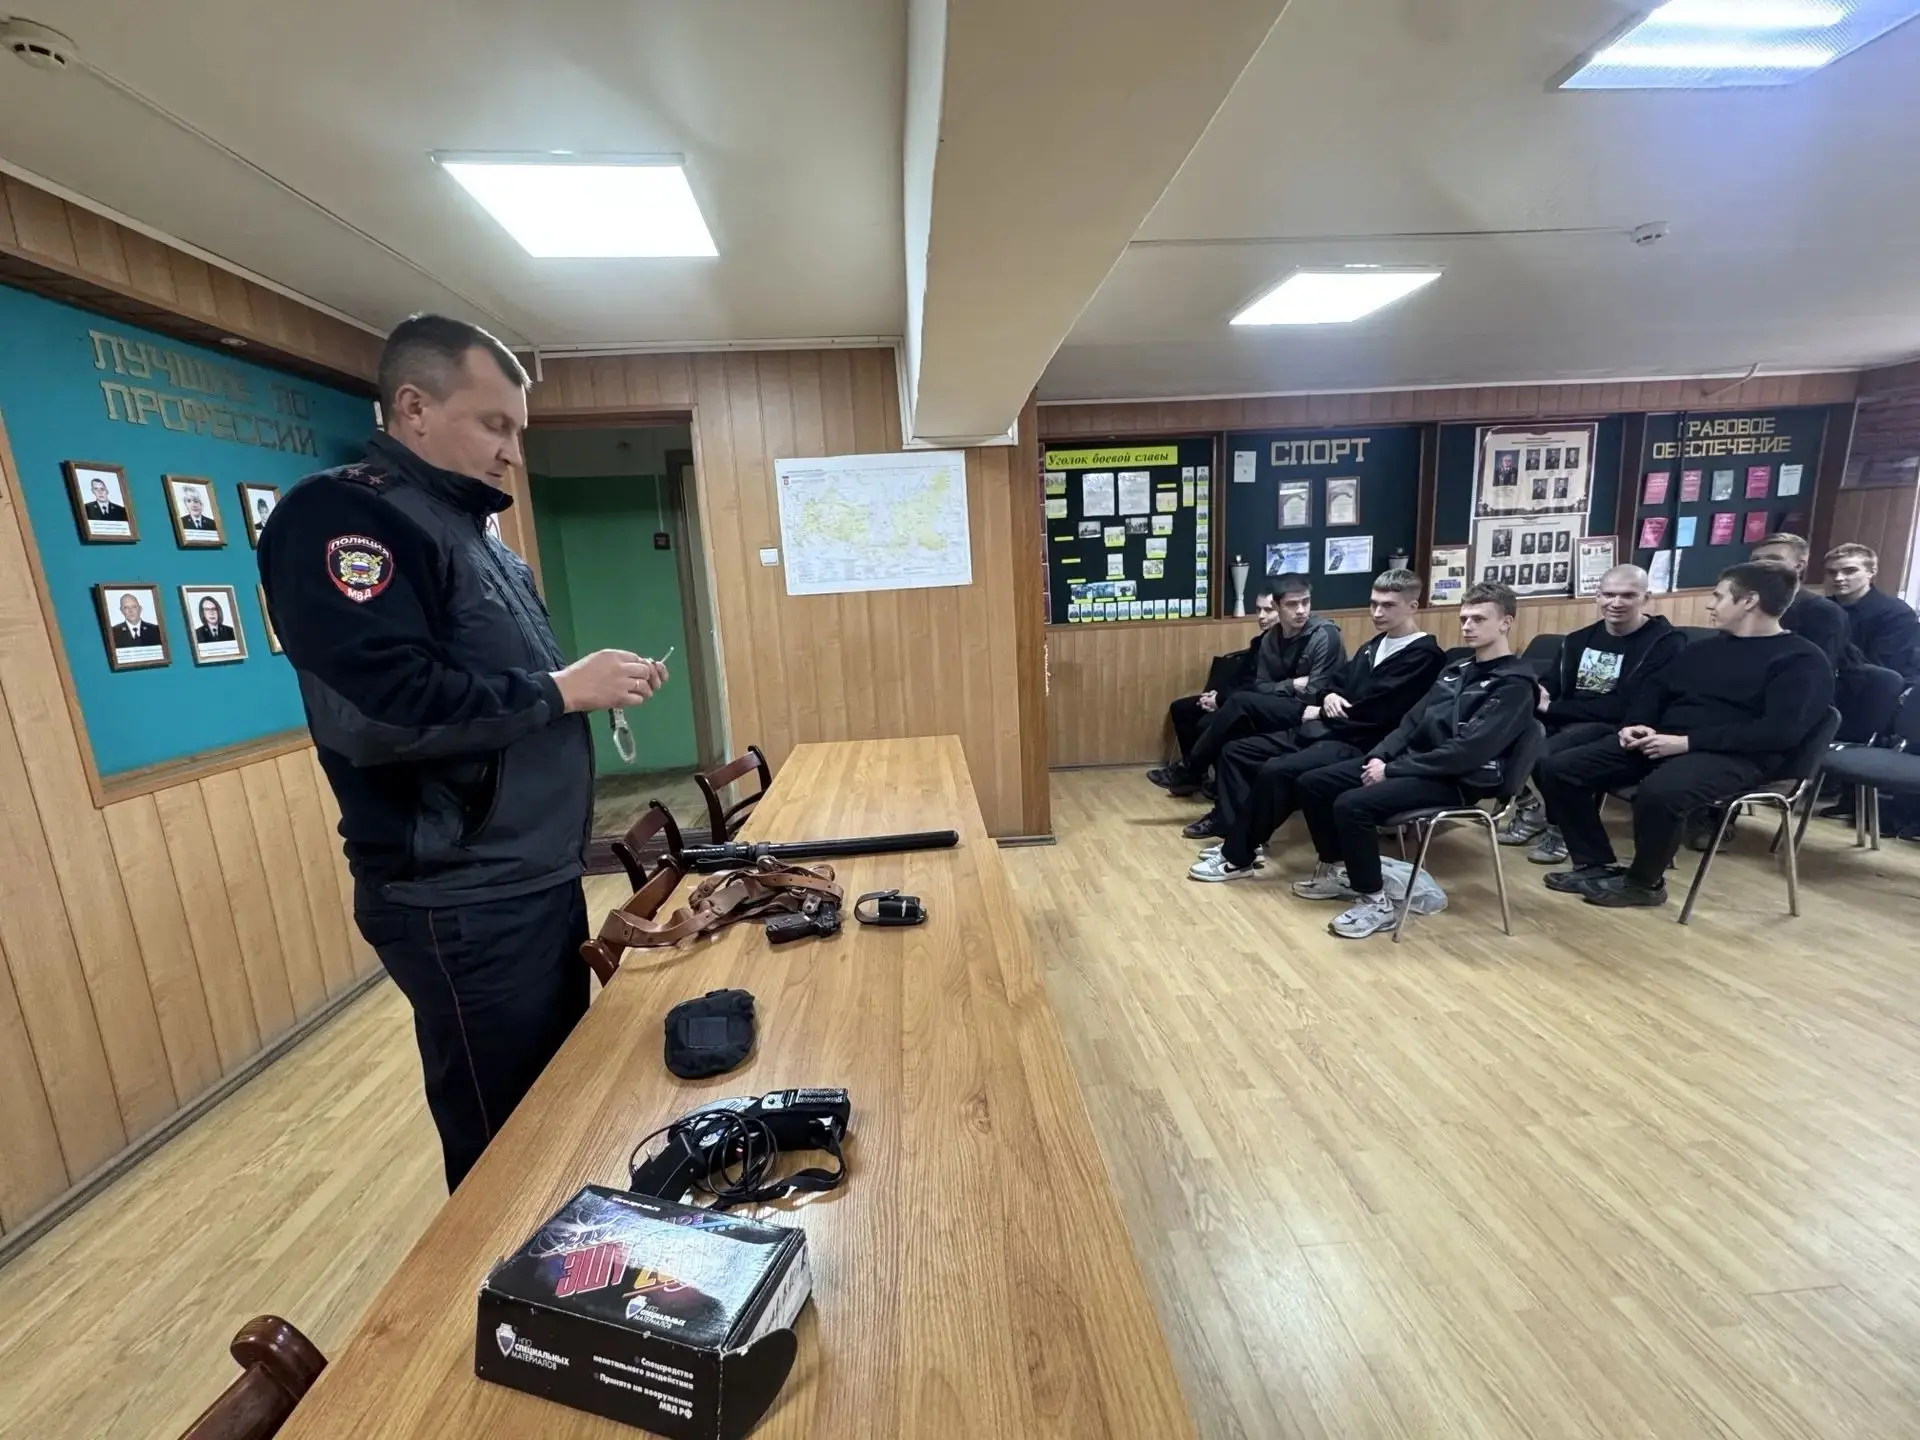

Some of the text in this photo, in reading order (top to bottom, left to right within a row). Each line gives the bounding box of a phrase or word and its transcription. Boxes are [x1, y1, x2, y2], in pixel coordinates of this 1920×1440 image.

[1271, 437, 1371, 466] СПОРТ
[1652, 436, 1792, 459] ОБЕСПЕЧЕНИЕ
[1047, 452, 1169, 466] Уголок боевой славы
[331, 537, 389, 559] ПОЛИЦИЯ
[347, 588, 372, 601] МВД
[511, 1350, 557, 1370] МАТЕРИАЛОВ
[514, 1343, 570, 1366] СПЕЦИАЛЬНЫХ
[641, 1357, 694, 1380] Спецсредство
[600, 1373, 632, 1390] Принято
[659, 1401, 694, 1420] МВД РФ
